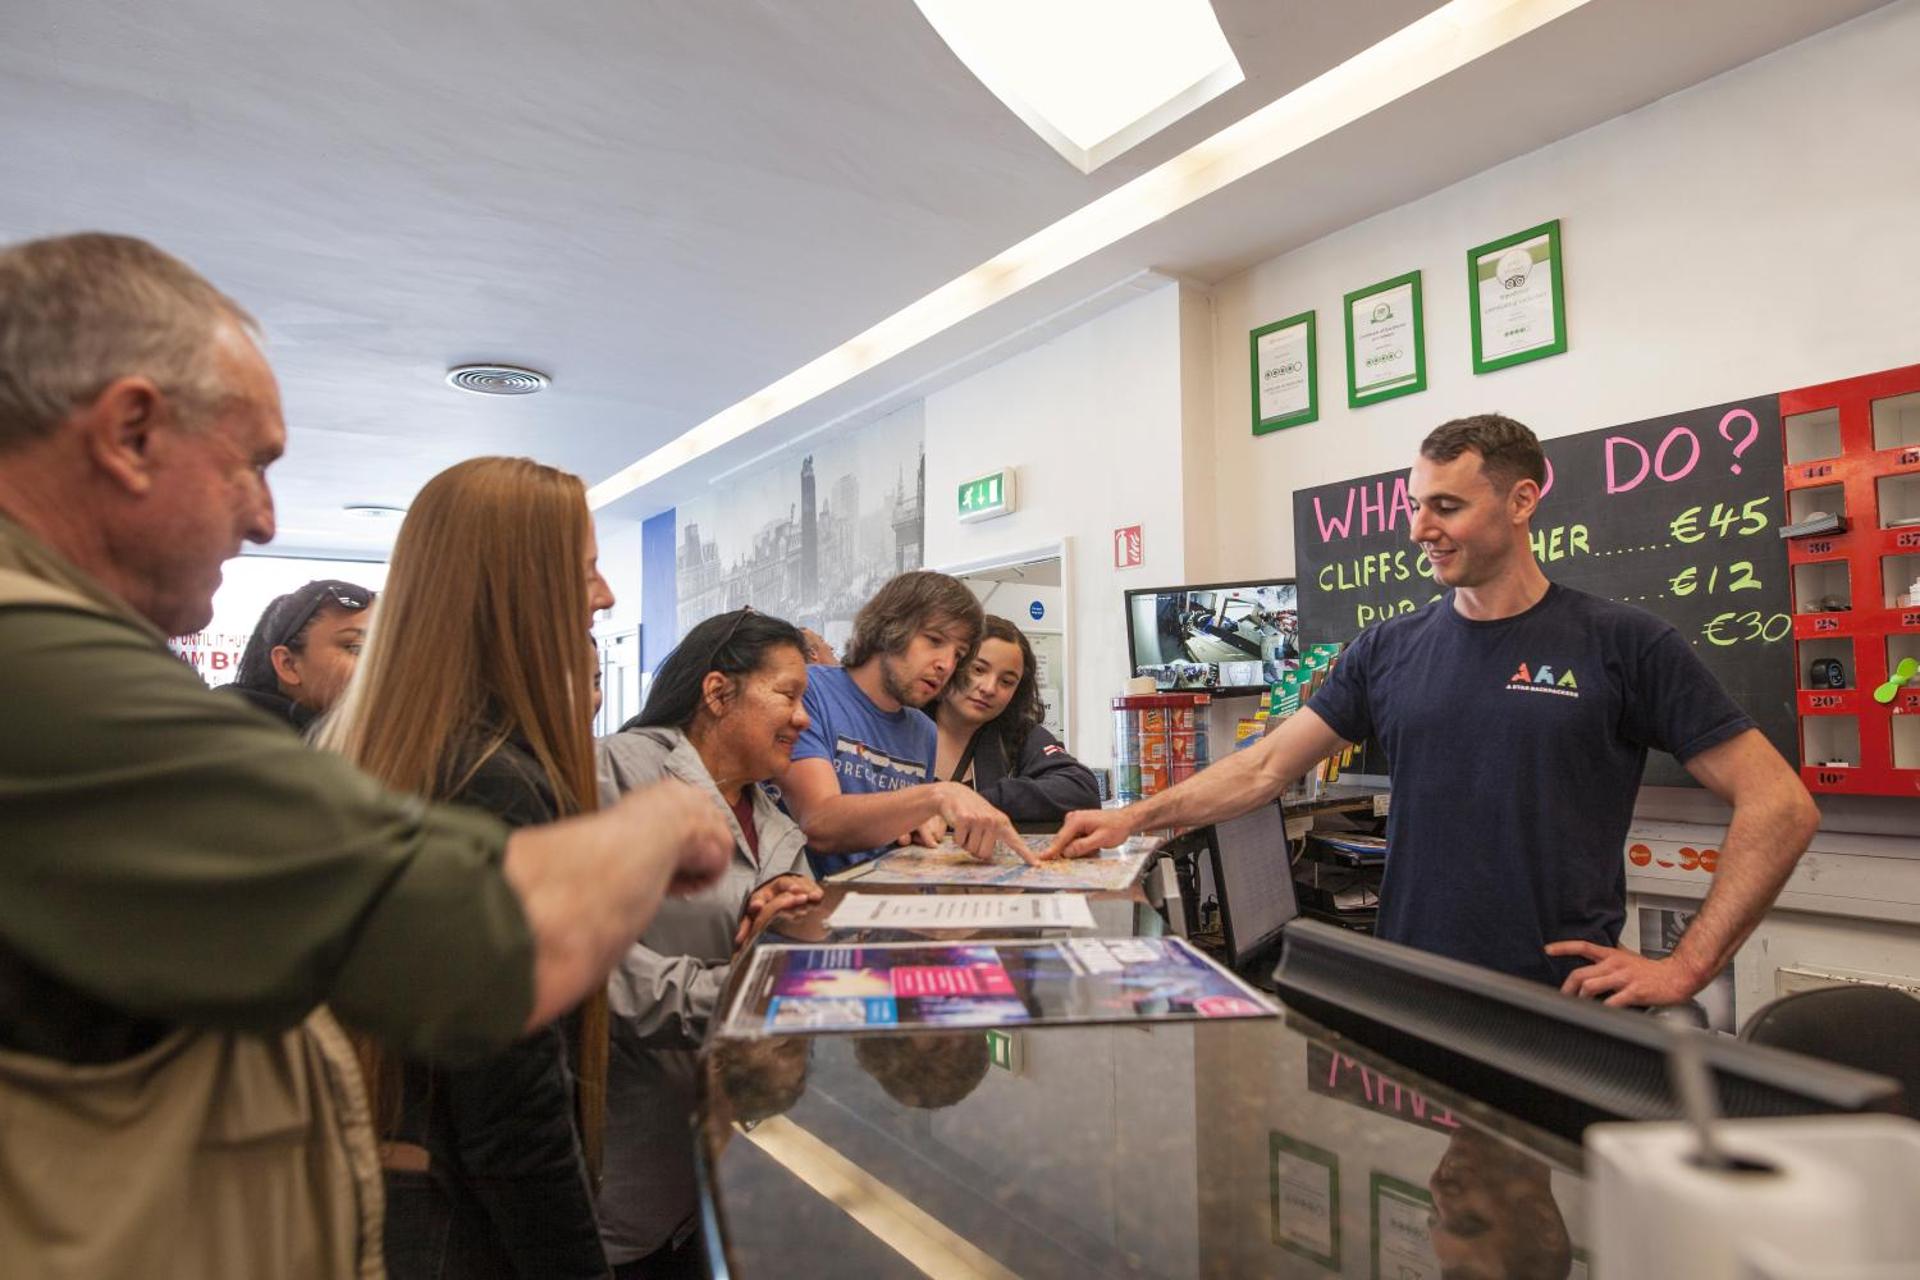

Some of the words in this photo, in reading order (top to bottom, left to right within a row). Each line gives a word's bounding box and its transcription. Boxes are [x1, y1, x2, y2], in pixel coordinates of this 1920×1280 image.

[1312, 477, 1414, 543] WHA
[1318, 550, 1410, 592] CLIFFS
[1669, 496, 1771, 544] €45
[1668, 561, 1763, 597] €12
[1700, 611, 1793, 646] €30
